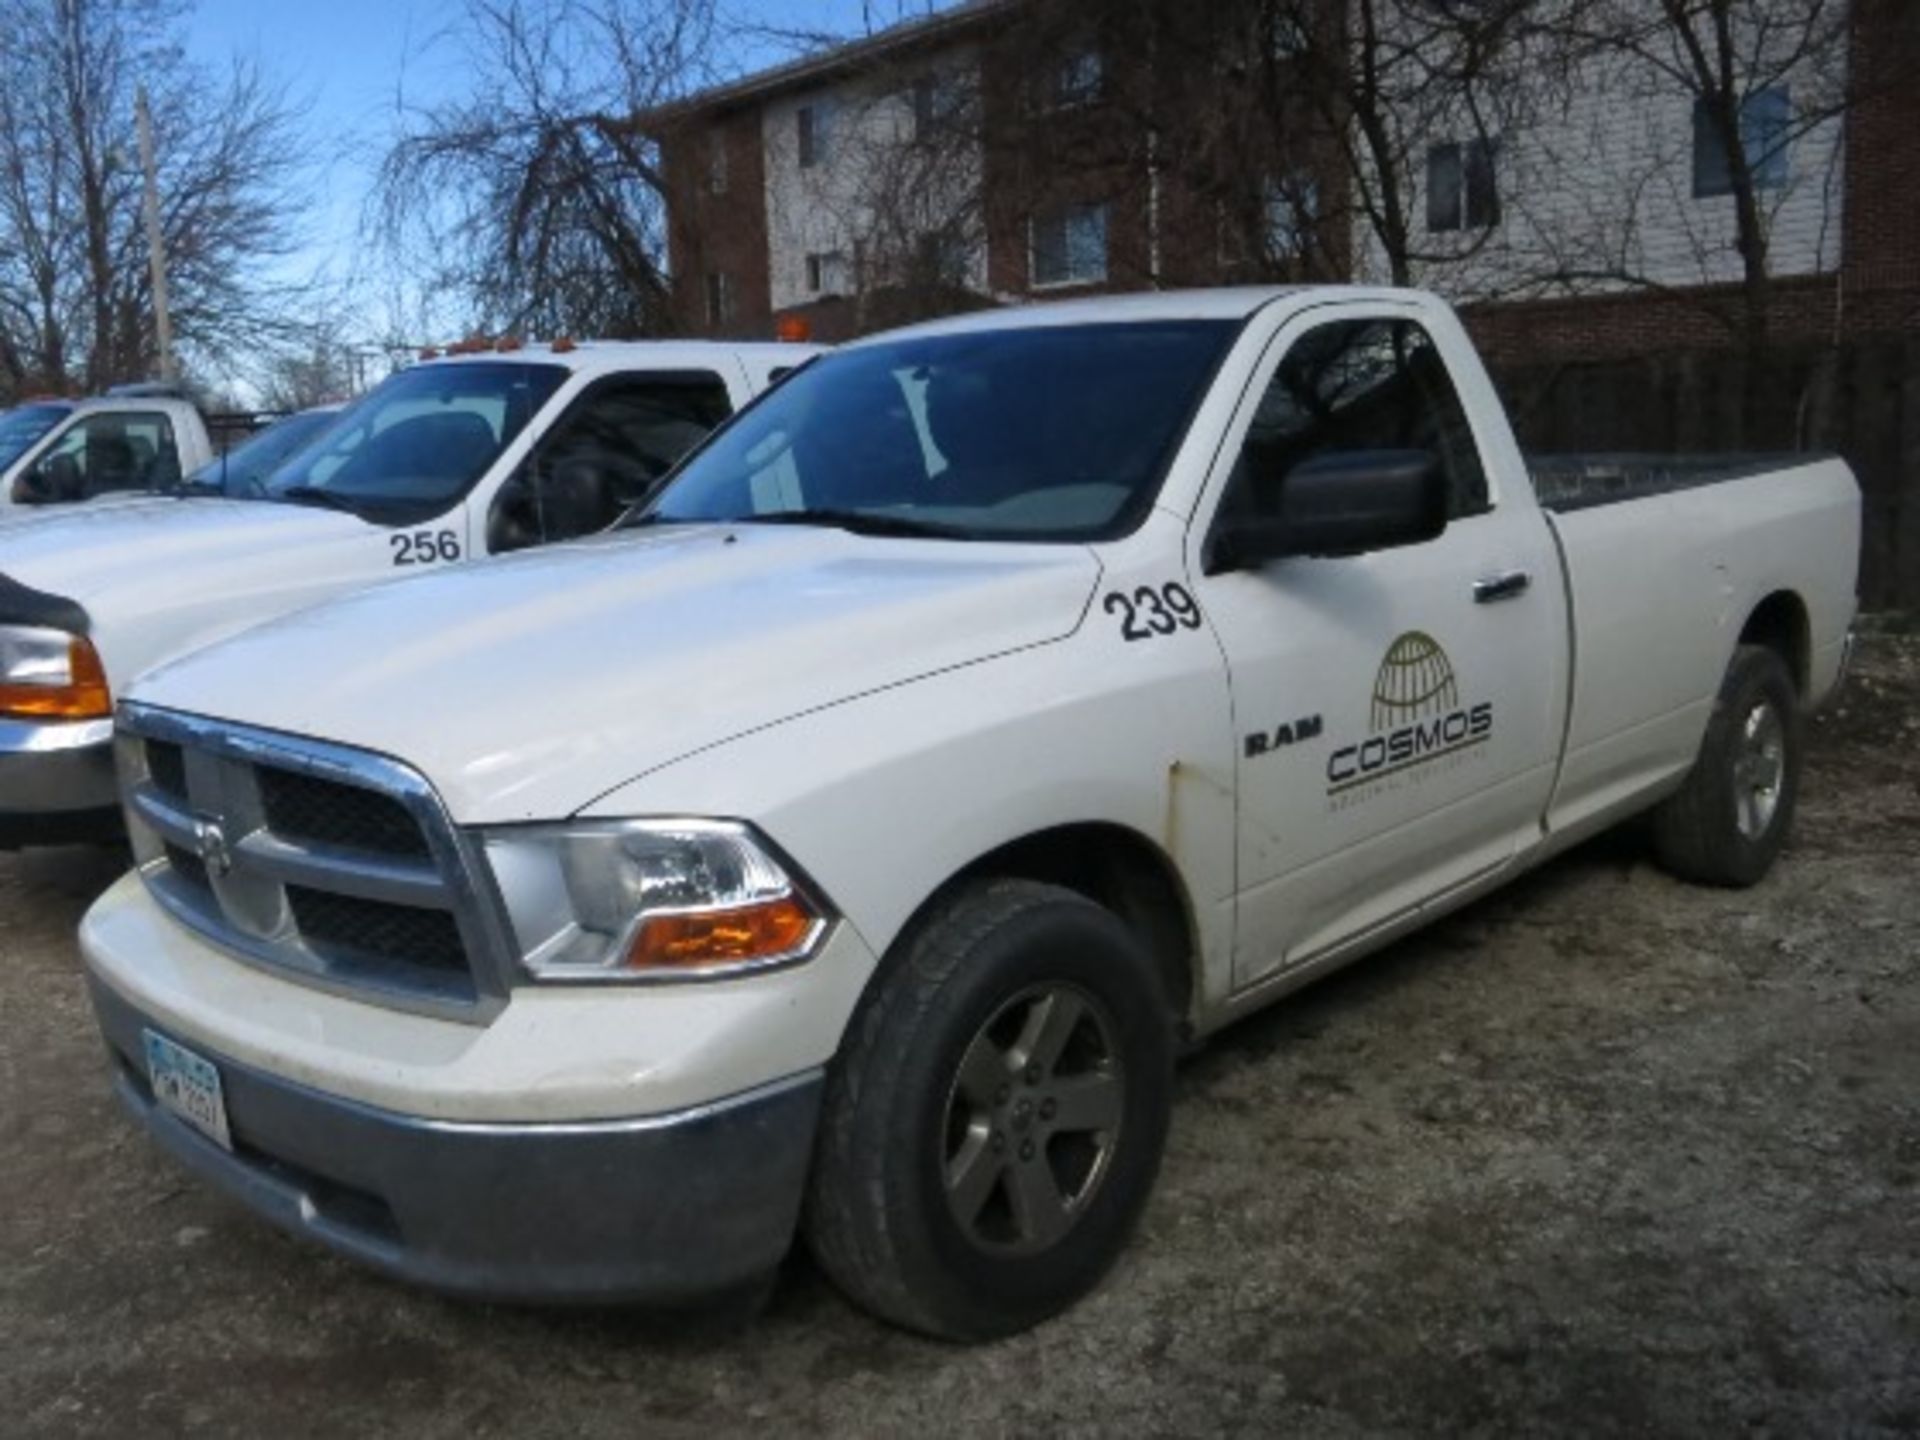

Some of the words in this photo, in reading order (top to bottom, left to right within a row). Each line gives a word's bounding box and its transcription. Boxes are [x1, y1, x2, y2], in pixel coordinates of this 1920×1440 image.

[390, 531, 460, 566] 256
[1104, 582, 1200, 641] 239
[1245, 714, 1322, 757] RAM
[1327, 702, 1492, 782] COSMOS
